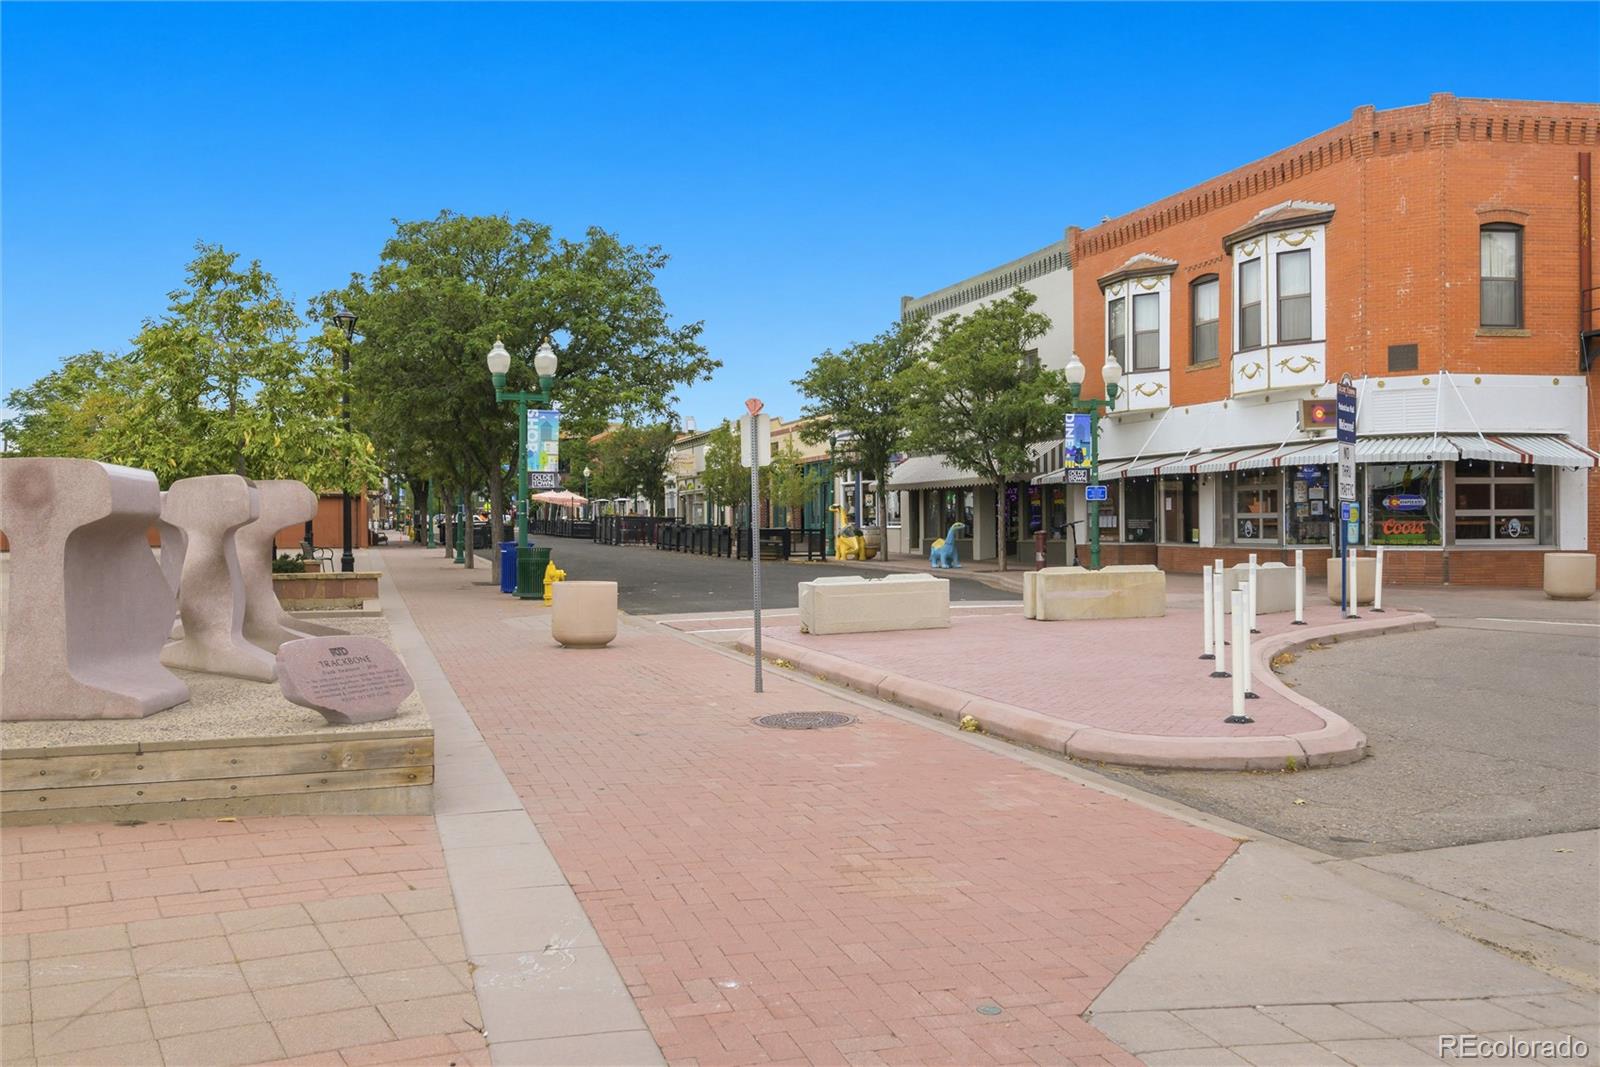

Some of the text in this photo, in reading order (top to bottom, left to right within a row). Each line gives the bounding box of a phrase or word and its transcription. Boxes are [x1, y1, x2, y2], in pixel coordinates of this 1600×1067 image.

[527, 410, 539, 451] SHOP
[1065, 414, 1075, 448] DINE
[532, 473, 554, 481] OLDE
[532, 480, 555, 488] TOWN
[1383, 518, 1425, 535] Coors
[318, 655, 371, 669] TRACKBONE
